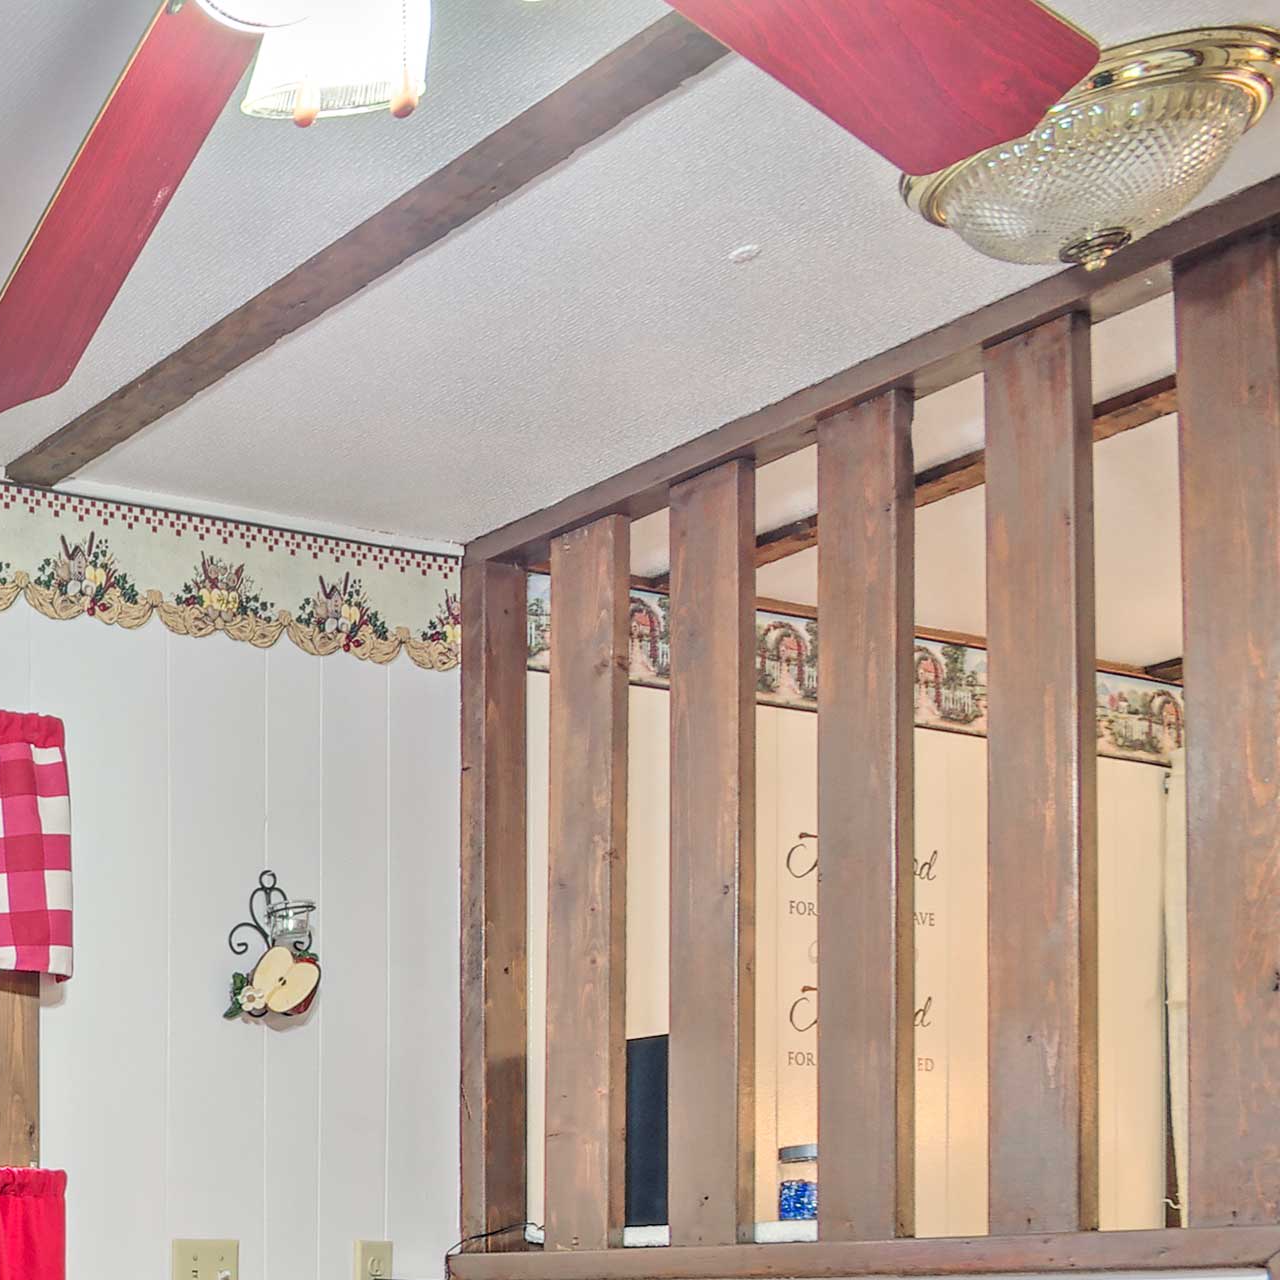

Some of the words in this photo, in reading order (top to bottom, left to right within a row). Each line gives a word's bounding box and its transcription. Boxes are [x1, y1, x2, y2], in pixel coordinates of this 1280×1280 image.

[789, 901, 818, 916] FOR
[913, 912, 935, 926] AVE
[788, 1052, 816, 1066] FOR
[917, 1059, 935, 1072] ED
